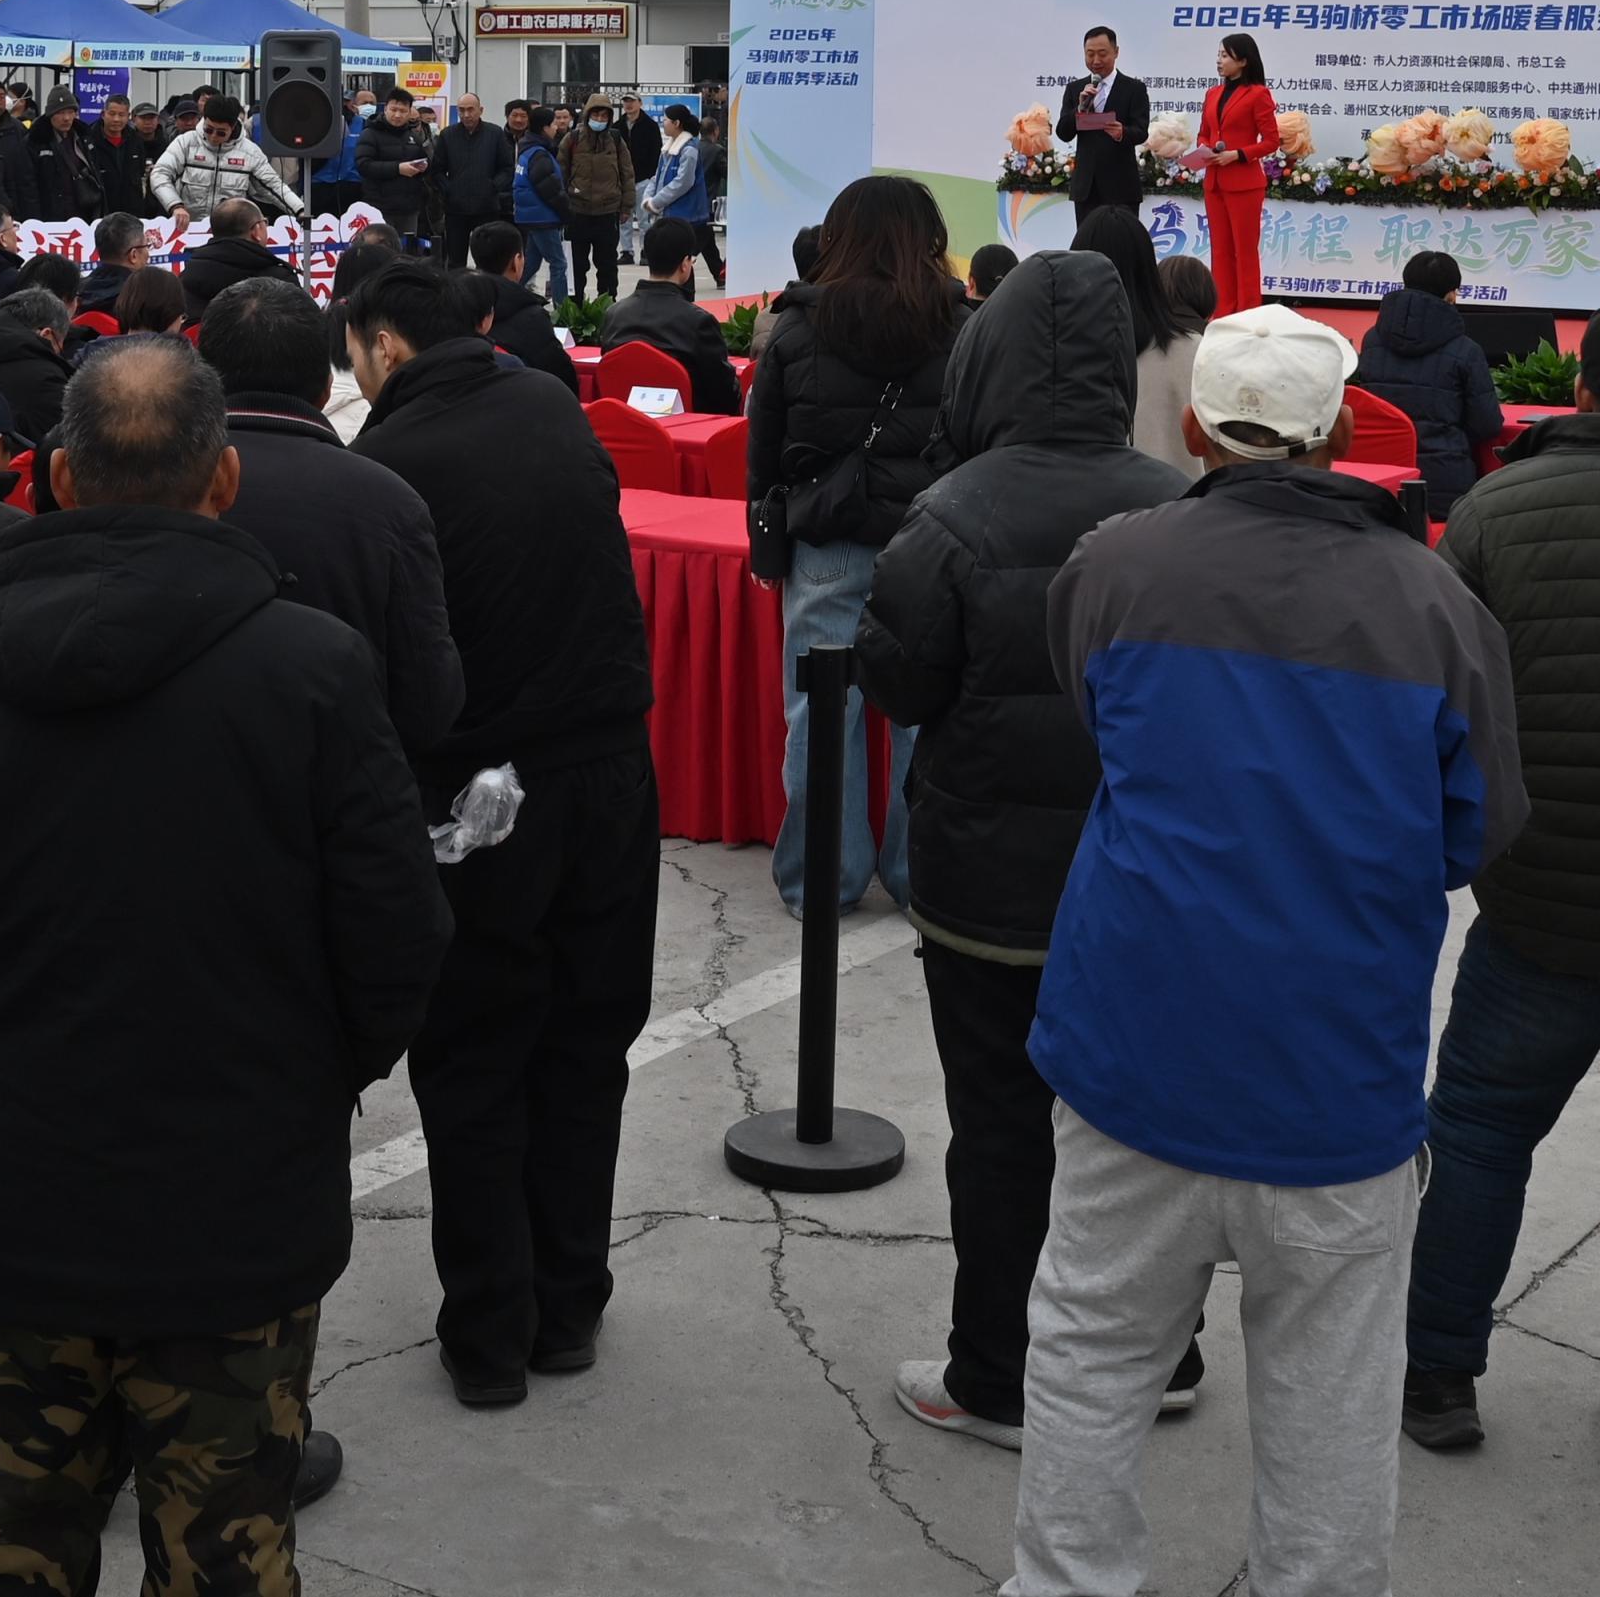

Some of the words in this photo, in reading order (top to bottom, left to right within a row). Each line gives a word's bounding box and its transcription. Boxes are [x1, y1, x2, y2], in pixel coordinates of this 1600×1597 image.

[769, 28, 836, 42] 2026年
[746, 49, 859, 64] 马驹桥零工市场
[1315, 54, 1567, 69] 指导单位：市人力资源和社会保障局、市总工会
[745, 71, 859, 86] 暖春服务季活动
